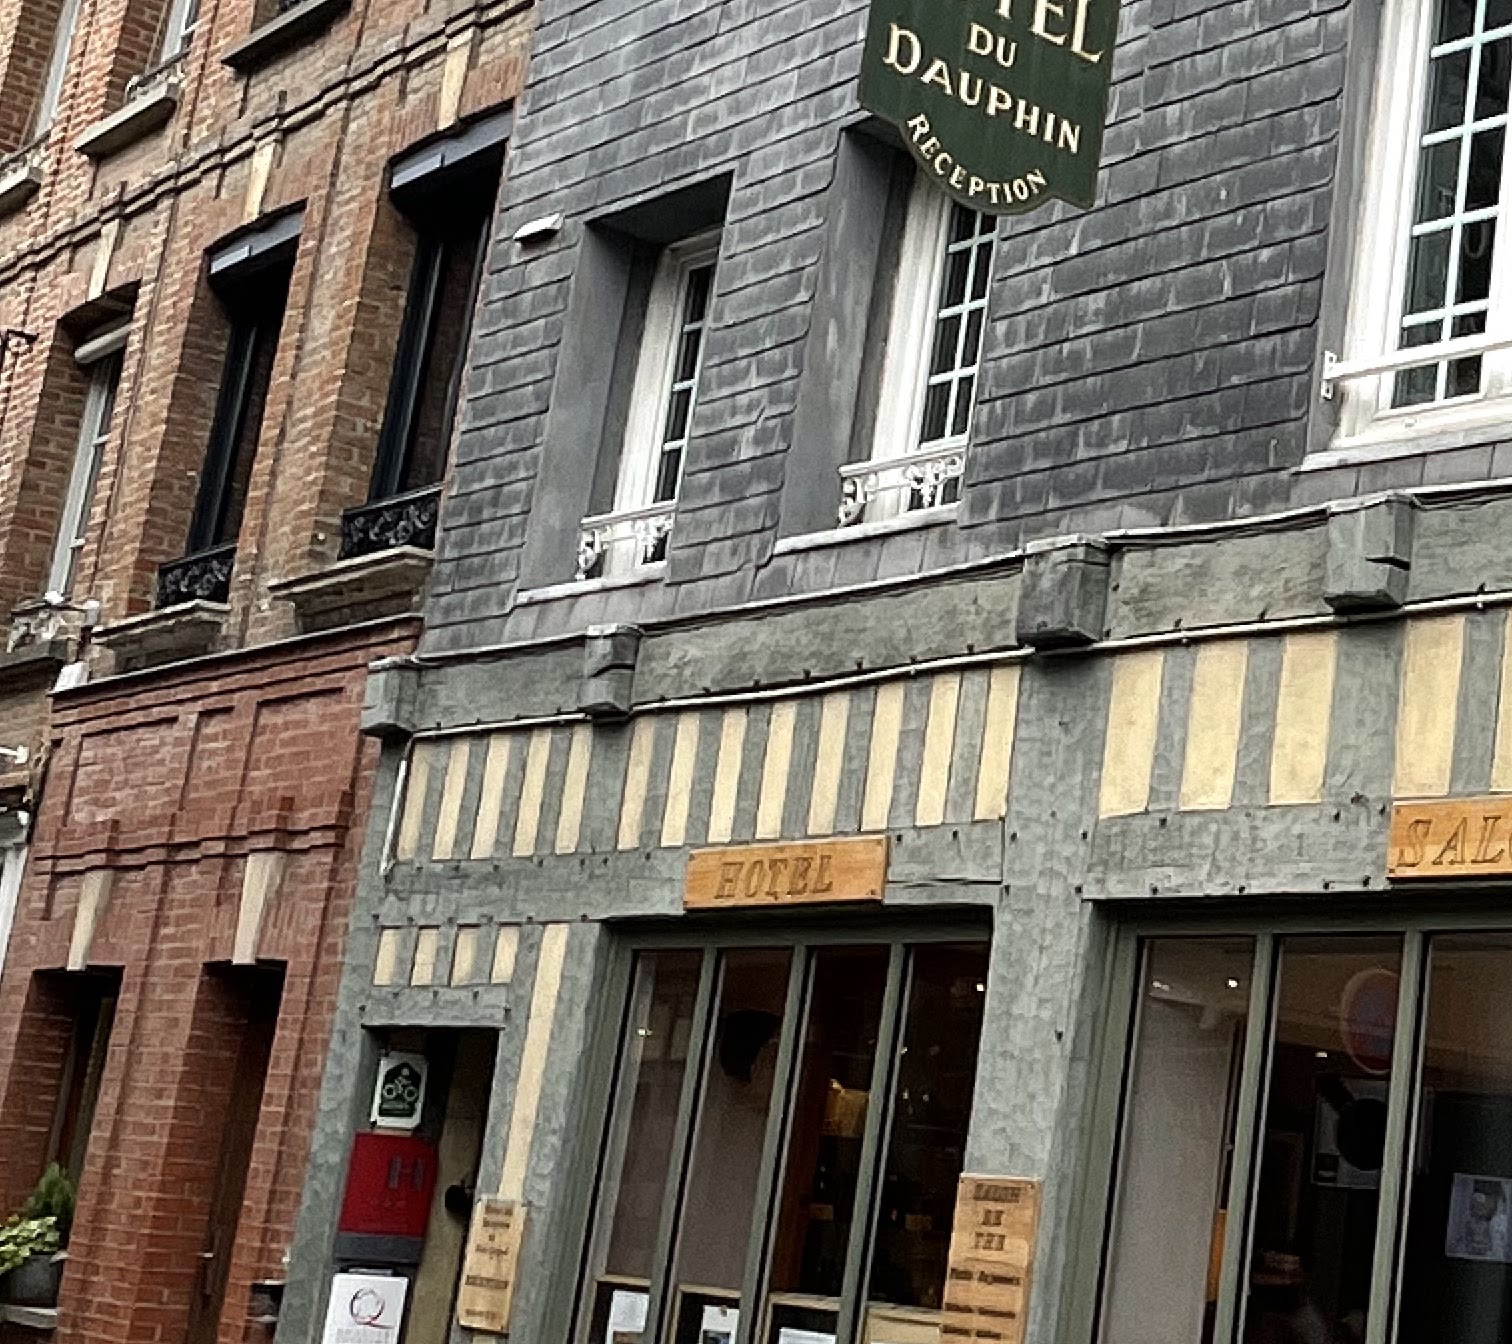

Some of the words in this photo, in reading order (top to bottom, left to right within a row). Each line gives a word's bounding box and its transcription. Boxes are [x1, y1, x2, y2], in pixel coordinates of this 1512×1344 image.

[967, 23, 1019, 68] DU
[883, 23, 1083, 154] DAUPHIN
[906, 113, 1049, 204] RECEPTION
[714, 854, 834, 900] HOTEL
